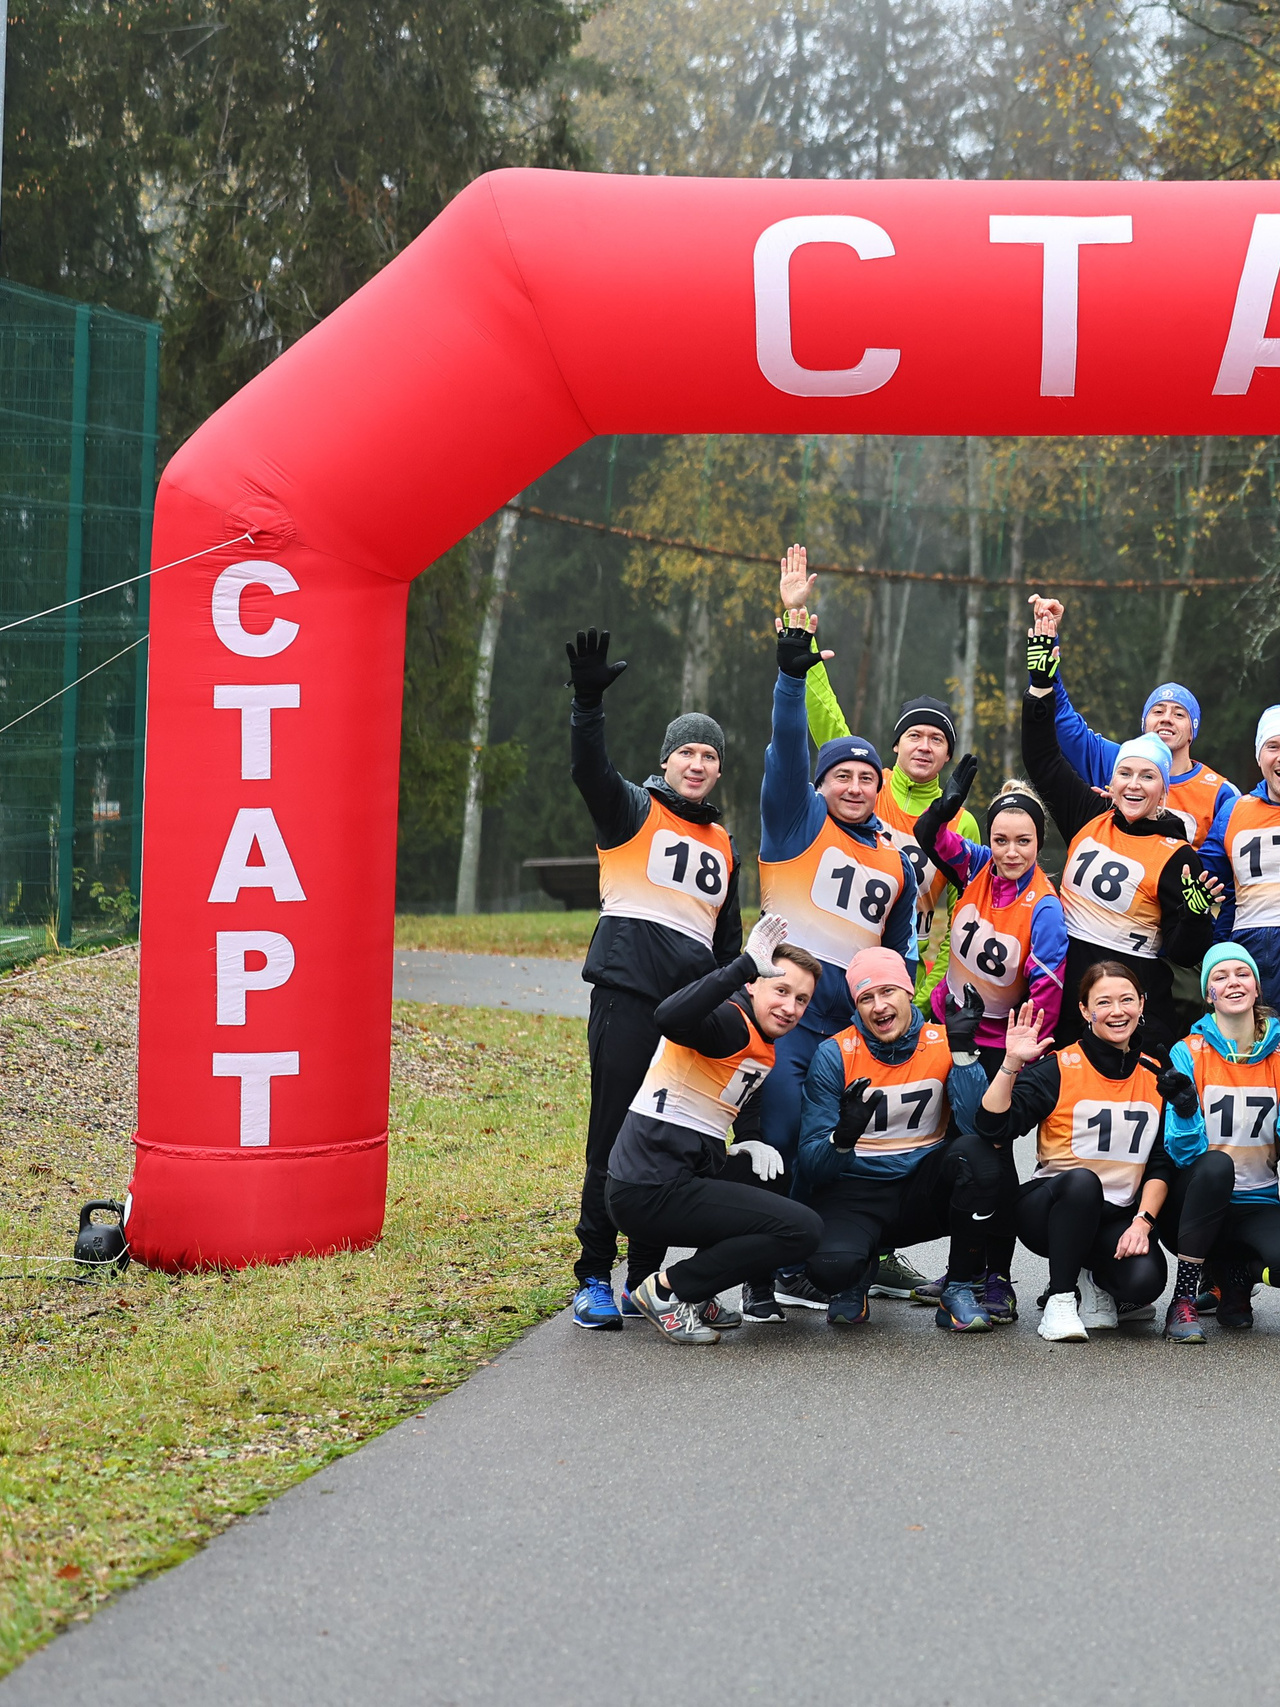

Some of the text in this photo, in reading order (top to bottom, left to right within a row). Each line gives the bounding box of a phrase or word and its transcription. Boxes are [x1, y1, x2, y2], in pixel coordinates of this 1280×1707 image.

[207, 559, 307, 1147] СТАРТ
[664, 841, 721, 895] 18
[1072, 849, 1130, 902] 18
[830, 864, 892, 924] 18
[958, 920, 1008, 977] 18
[1128, 932, 1148, 952] 7
[872, 1088, 933, 1132] 17
[1087, 1108, 1149, 1154] 17
[1209, 1094, 1275, 1138] 17
